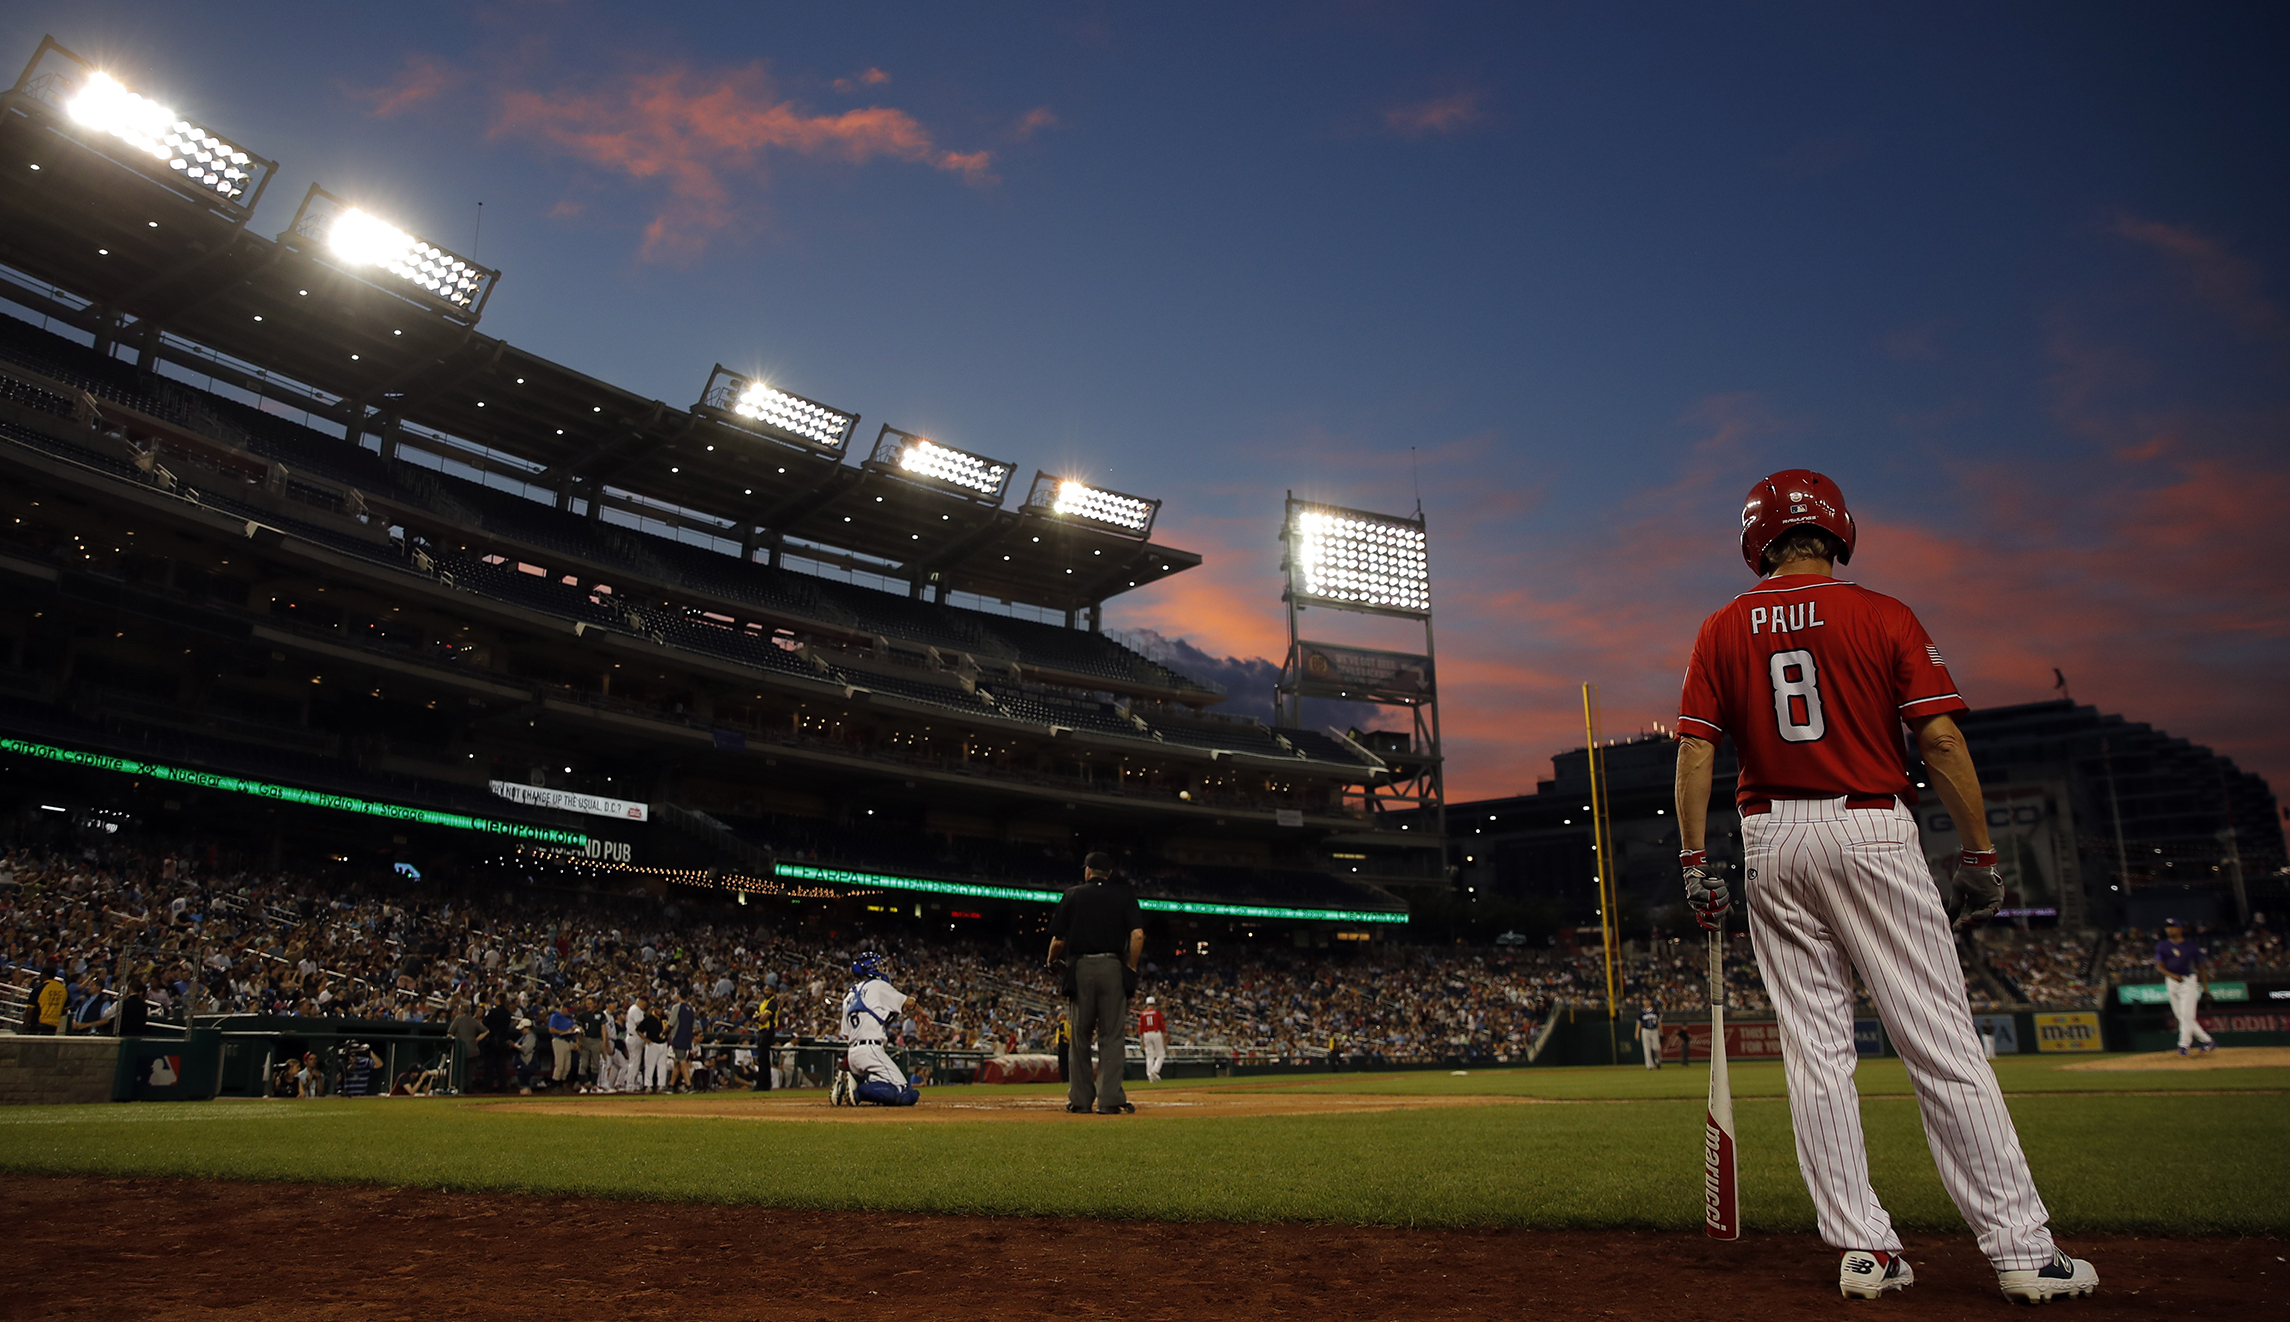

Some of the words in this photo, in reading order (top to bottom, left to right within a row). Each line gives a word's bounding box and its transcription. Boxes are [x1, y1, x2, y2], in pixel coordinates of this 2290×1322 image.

[1751, 601, 1825, 634] PAUL
[1769, 648, 1826, 744] 8
[168, 767, 220, 787] Nuclear
[259, 783, 283, 799] Gas
[318, 793, 353, 810] Hydro
[506, 785, 521, 799] NOT
[522, 788, 551, 804] CHANGE
[552, 794, 563, 805] UP
[564, 795, 577, 808] THE
[603, 840, 632, 863] PUB
[1705, 1122, 1727, 1232] marucci
